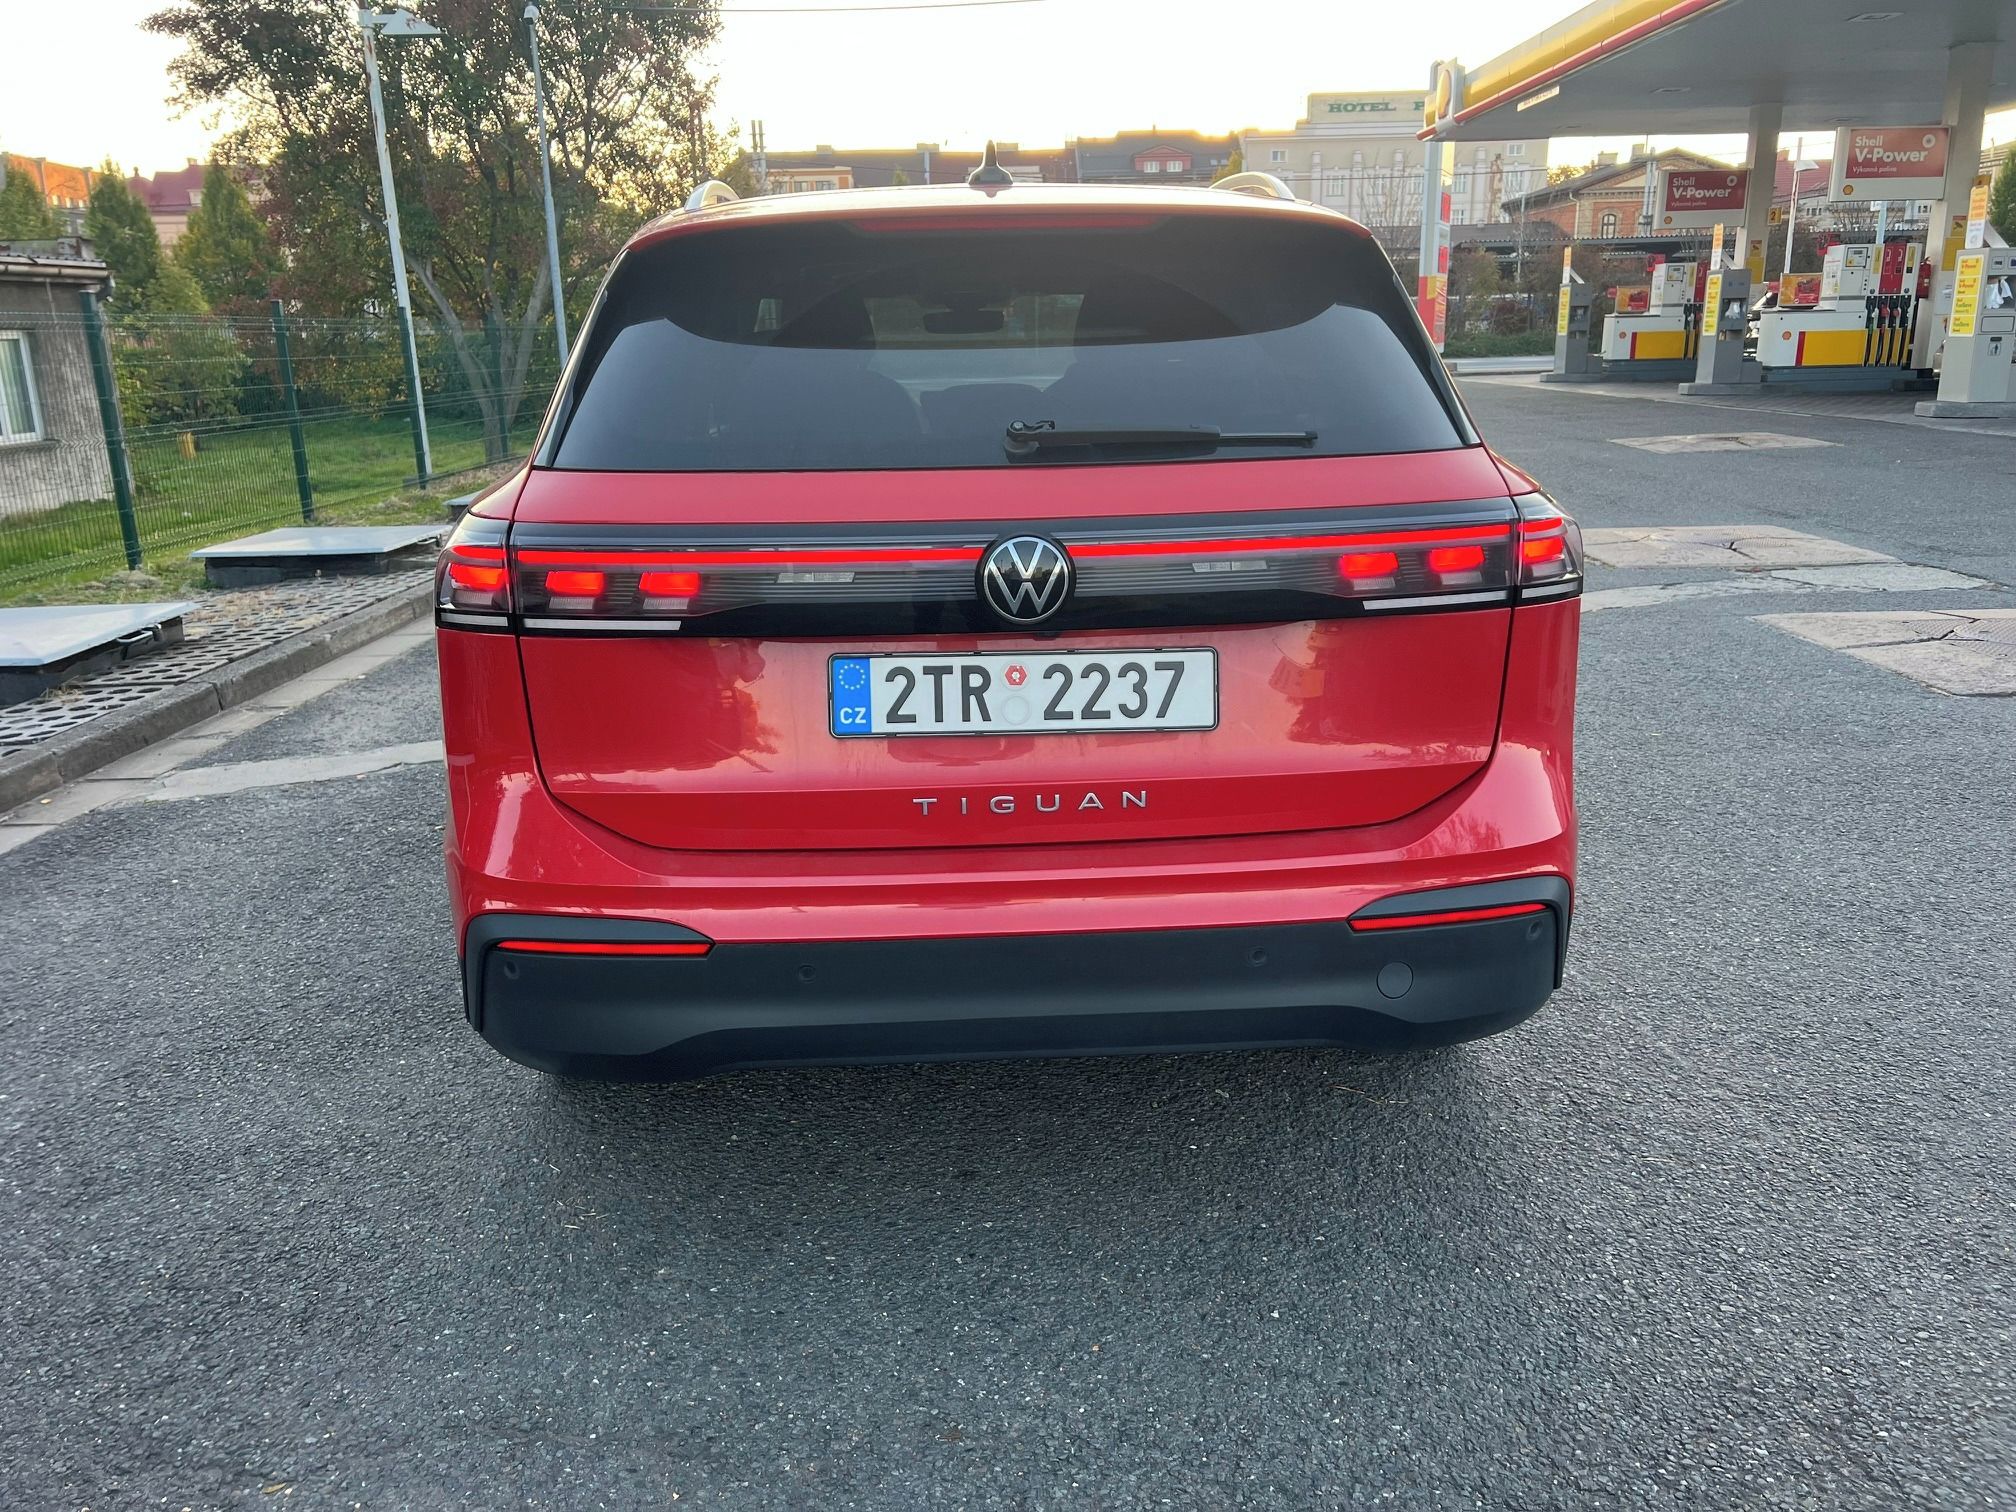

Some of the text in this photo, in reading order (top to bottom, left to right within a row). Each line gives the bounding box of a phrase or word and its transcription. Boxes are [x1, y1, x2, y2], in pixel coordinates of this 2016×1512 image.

[1328, 102, 1396, 113] HOTEL
[1855, 135, 1883, 147] Shell
[1855, 148, 1928, 162] V-Power
[1673, 177, 1695, 187] Shell
[1672, 187, 1731, 199] V-Power
[885, 661, 1185, 724] 2TR 2237
[840, 707, 866, 724] CZ
[912, 790, 1147, 816] TIGUAN
